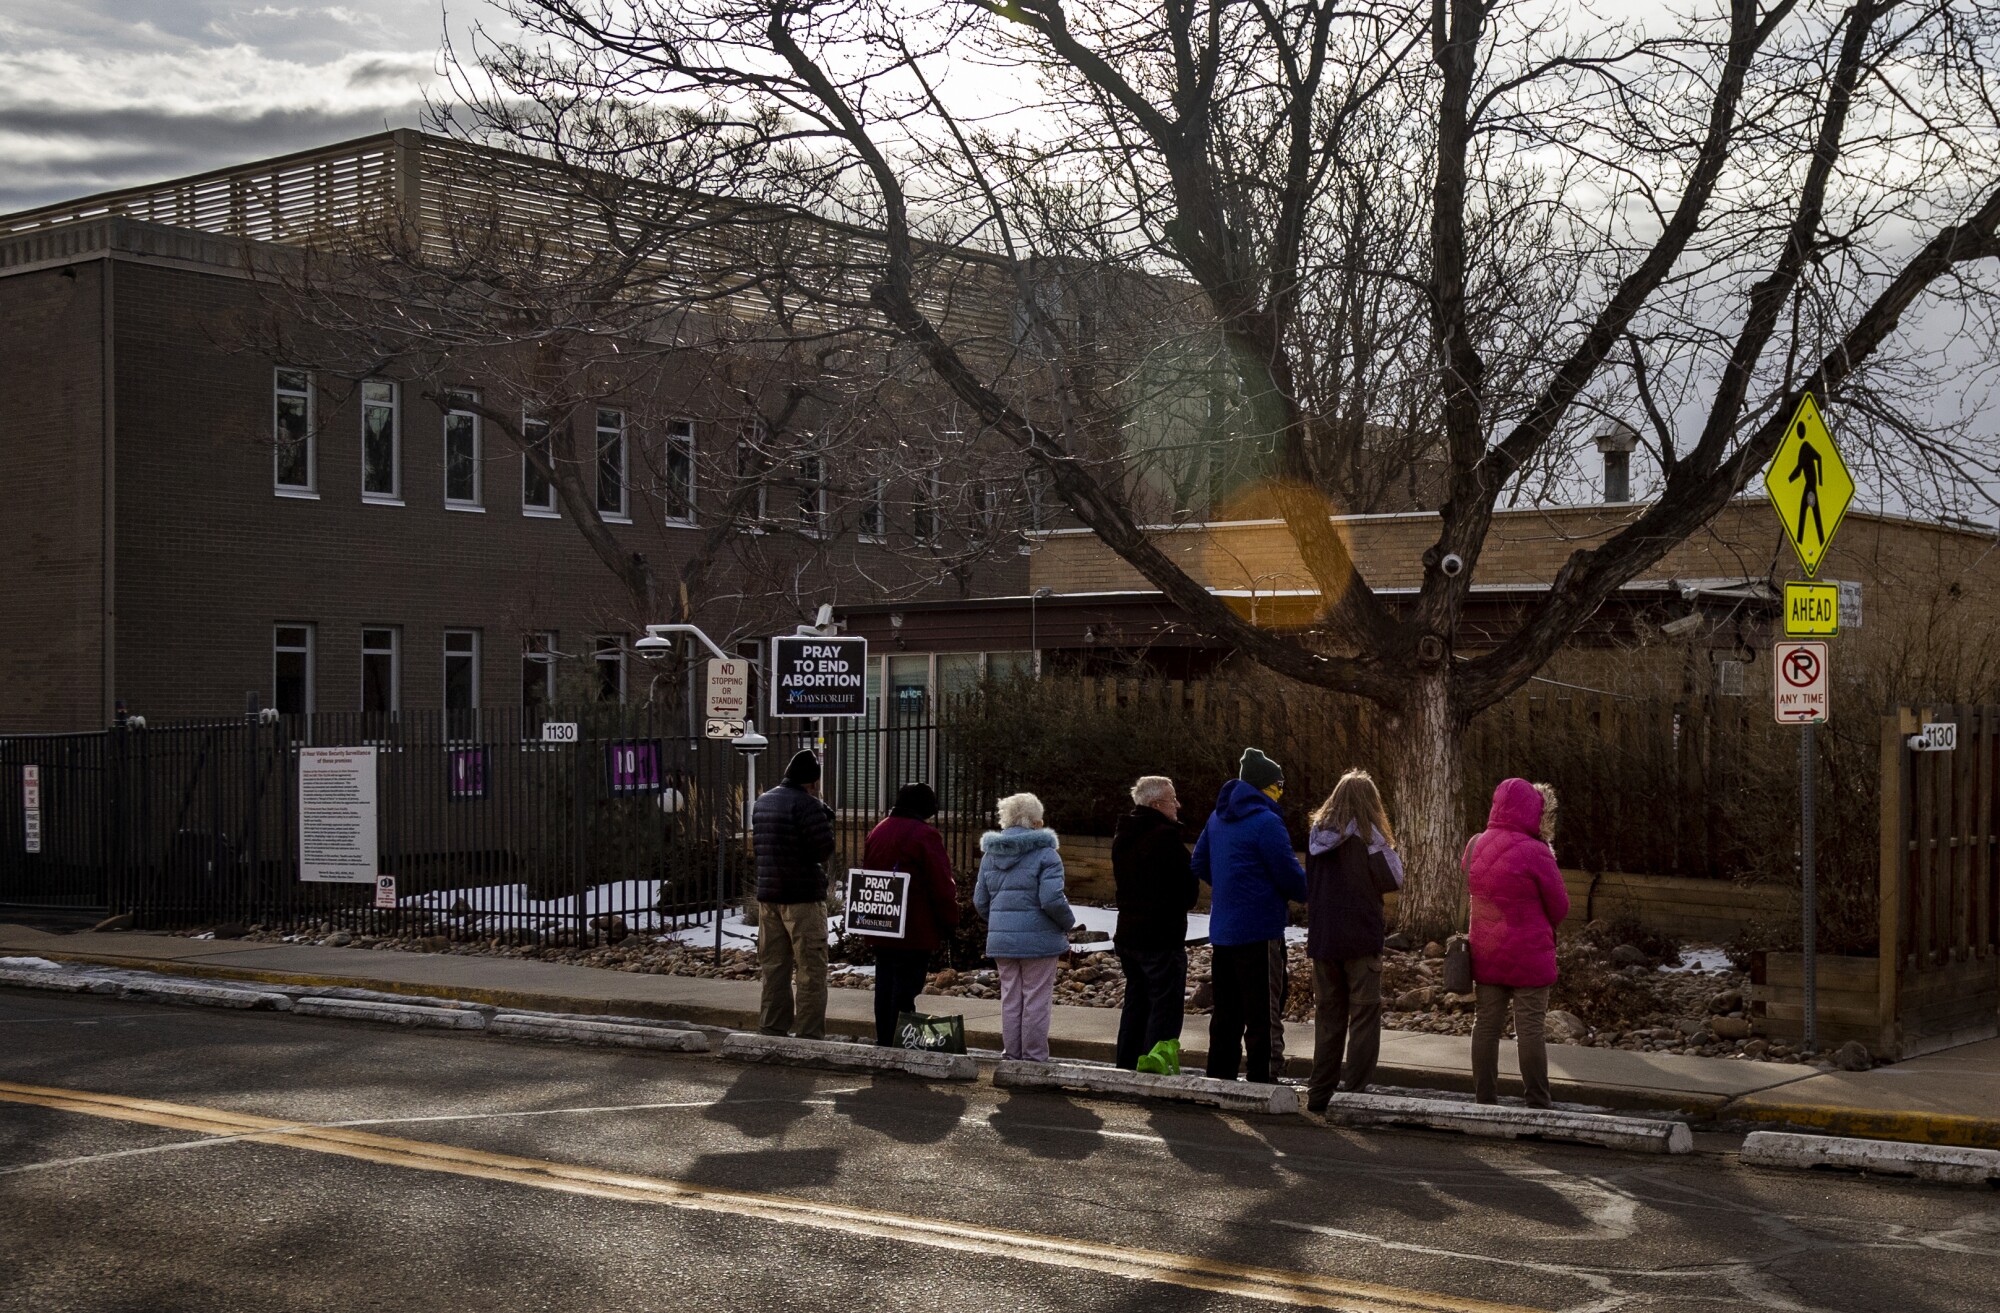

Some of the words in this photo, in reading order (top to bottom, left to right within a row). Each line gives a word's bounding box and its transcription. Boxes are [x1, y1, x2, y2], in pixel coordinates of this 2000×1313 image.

[1792, 598, 1832, 622] AHEAD
[802, 645, 842, 658] PRAY
[721, 664, 735, 675] NO
[793, 660, 815, 673] TO
[818, 660, 849, 673] END
[711, 677, 743, 686] STOPPING
[781, 674, 861, 687] ABORTION
[722, 687, 732, 695] OR
[711, 697, 743, 705] STANDING
[1779, 693, 1798, 704] ANY
[1803, 693, 1824, 704] TIME
[546, 725, 574, 740] 1130
[1926, 726, 1954, 747] 1130
[864, 876, 891, 890] PRAY
[858, 888, 872, 901] TO
[873, 890, 895, 903] END
[850, 901, 900, 917] ABORTION
